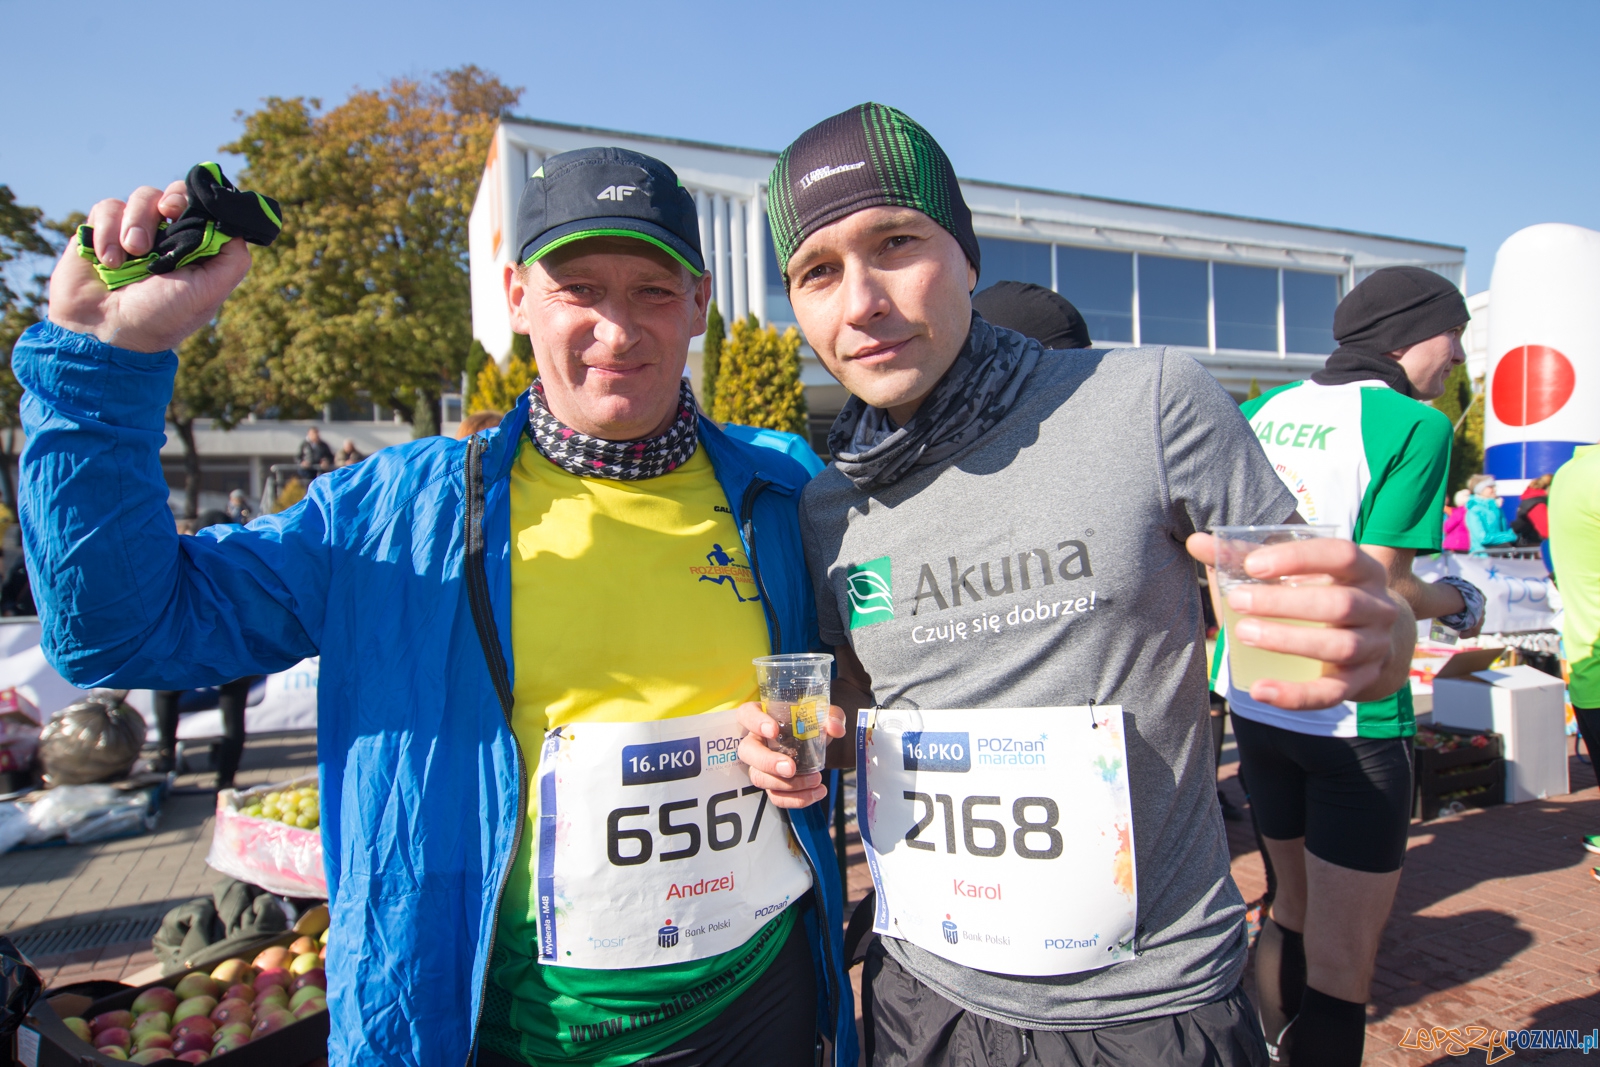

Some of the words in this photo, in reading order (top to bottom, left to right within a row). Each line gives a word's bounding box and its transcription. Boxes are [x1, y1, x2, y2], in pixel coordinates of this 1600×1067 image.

[597, 185, 637, 202] 4F
[911, 539, 1094, 616] Akuna
[911, 619, 967, 644] Czuję
[973, 612, 1000, 632] się
[1006, 591, 1096, 625] dobrze!
[629, 756, 655, 773] 16.
[659, 750, 695, 771] PKO
[907, 743, 926, 760] 16.
[929, 743, 964, 761] PKO
[978, 752, 1046, 765] maraton
[606, 786, 768, 867] 6567
[903, 790, 1064, 860] 2168
[666, 871, 735, 901] Andrzej
[953, 878, 1002, 901] Karol
[685, 924, 706, 938] Bank
[708, 919, 731, 933] Polski
[962, 930, 982, 943] Bank
[985, 934, 1011, 946] Polski
